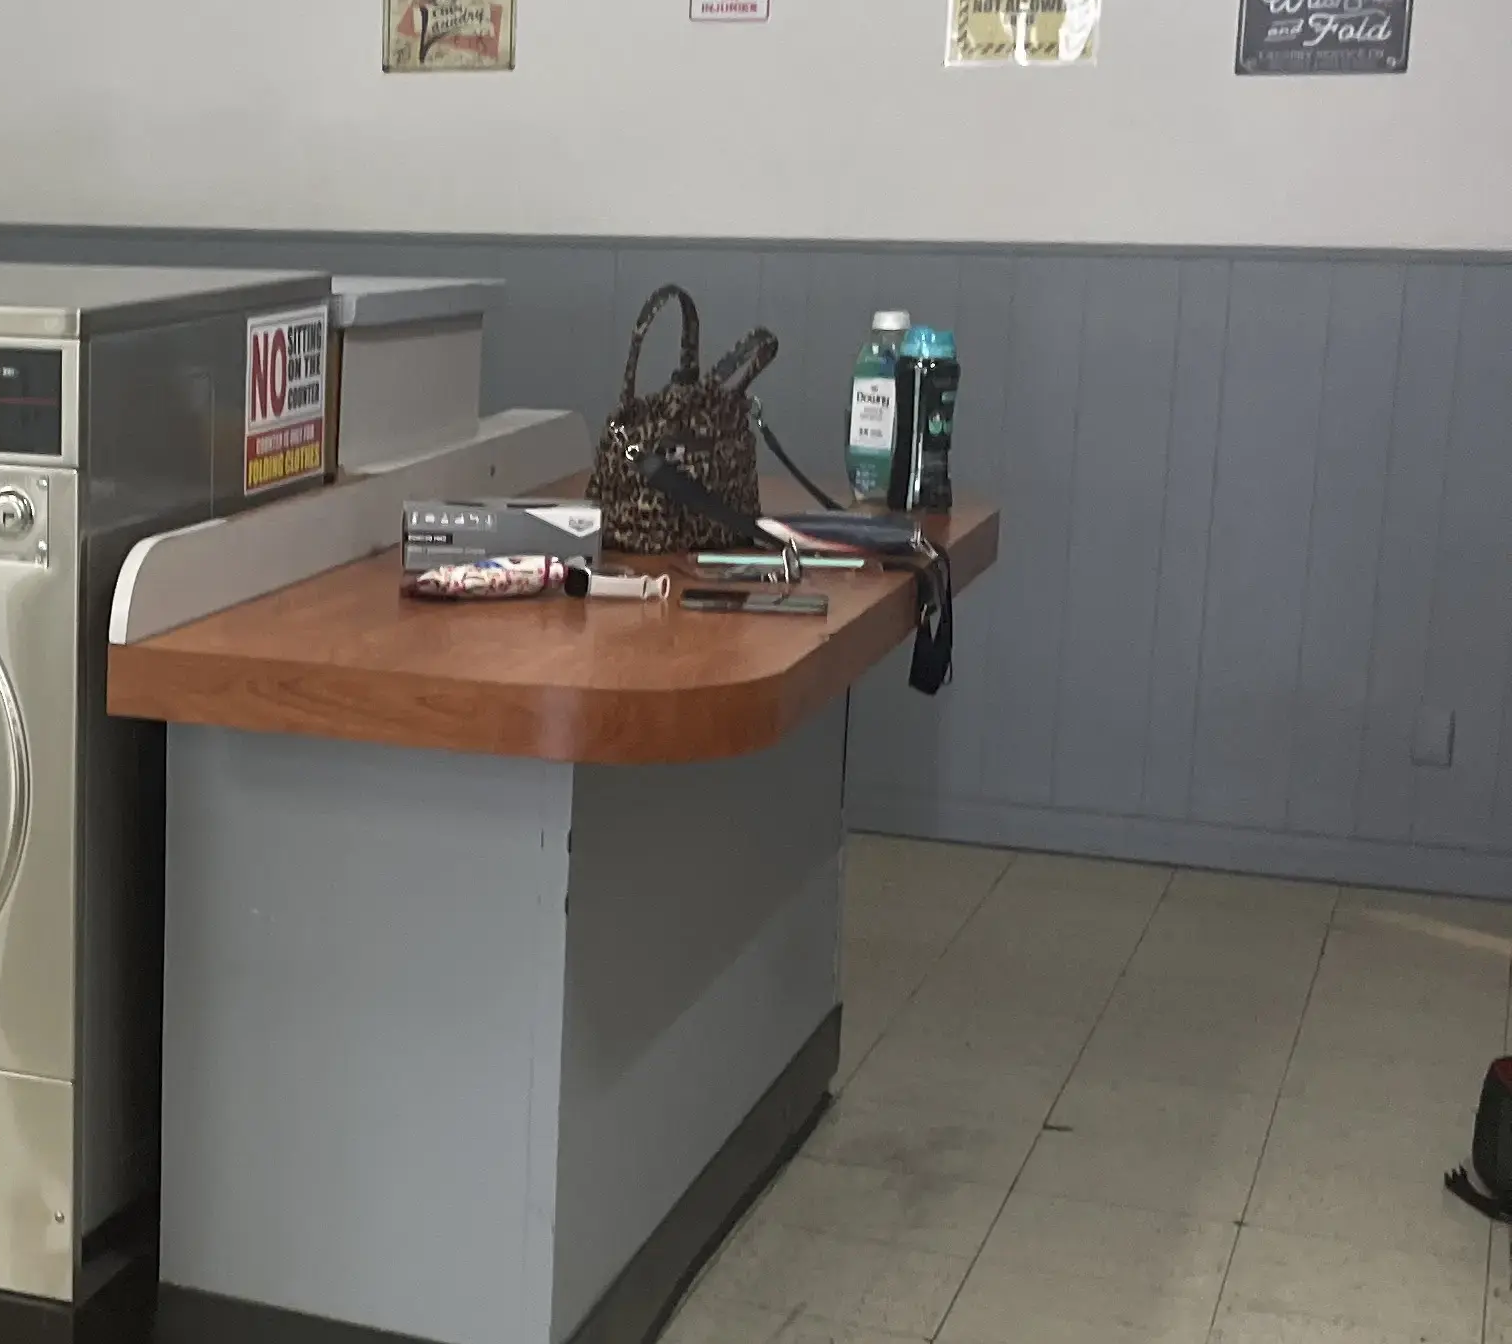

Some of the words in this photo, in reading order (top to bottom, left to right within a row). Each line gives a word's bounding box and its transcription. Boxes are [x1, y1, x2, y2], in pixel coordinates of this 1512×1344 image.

[700, 2, 757, 14] INJURIES
[1303, 13, 1393, 47] Fold
[288, 320, 322, 356] SITTING
[250, 327, 288, 423] NO
[288, 356, 302, 382] ON
[304, 353, 321, 378] THE
[288, 382, 320, 411] COUNTER
[248, 453, 284, 488] FOLDING
